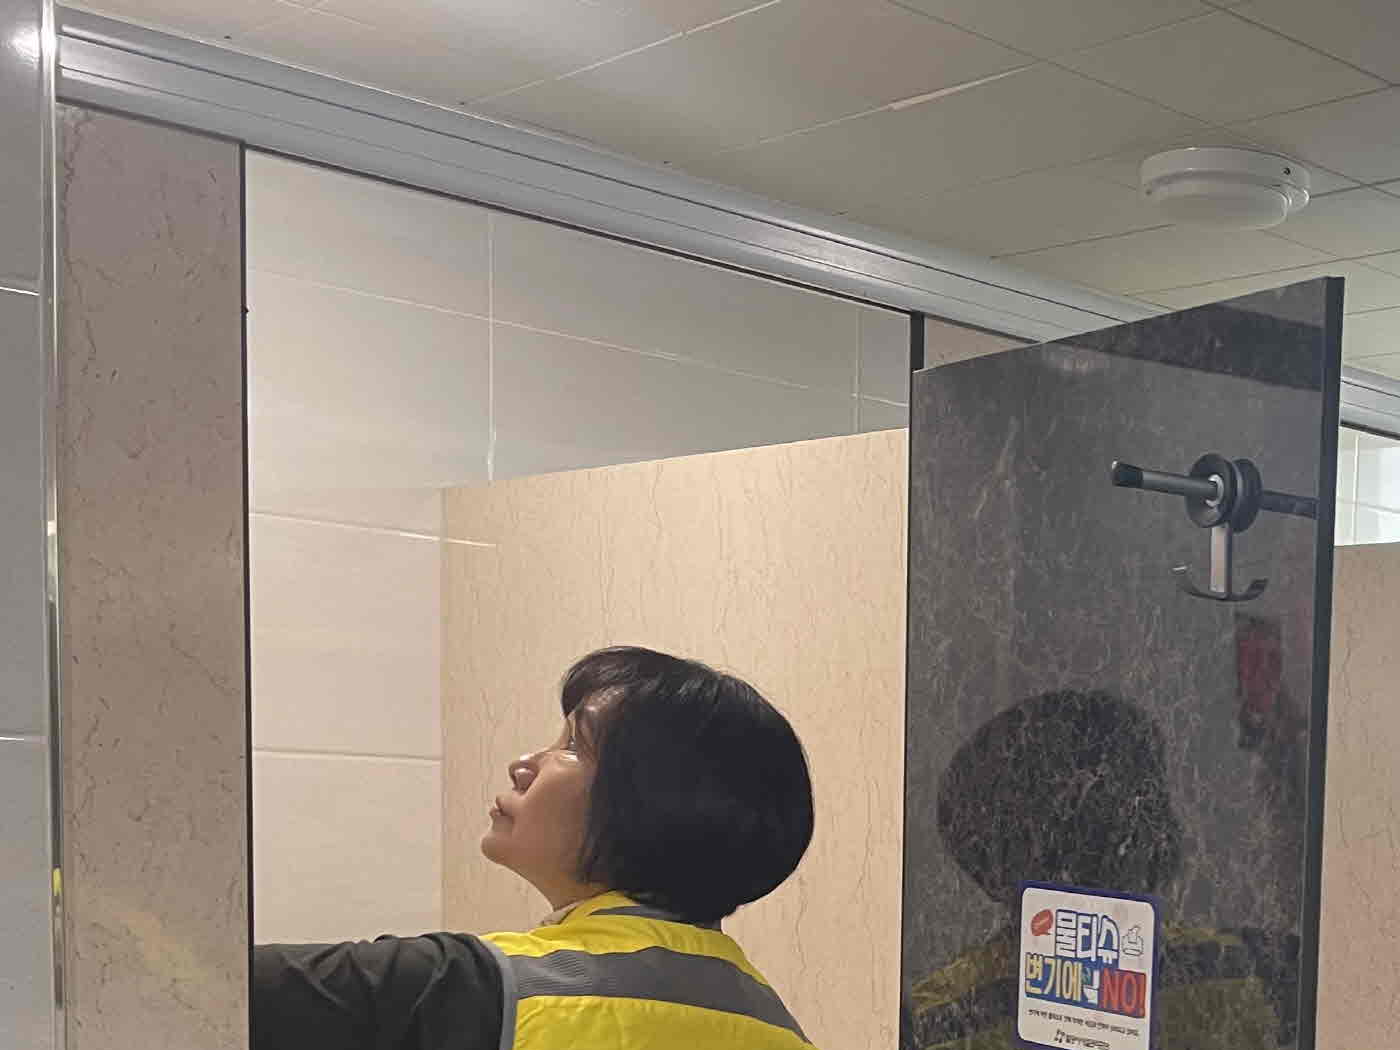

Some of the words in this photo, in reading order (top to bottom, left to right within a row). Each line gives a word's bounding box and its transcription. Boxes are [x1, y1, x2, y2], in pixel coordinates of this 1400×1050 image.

[1055, 908, 1120, 965] 물티슈
[1024, 952, 1083, 1002] 변기에
[1103, 967, 1146, 1016] NO!
